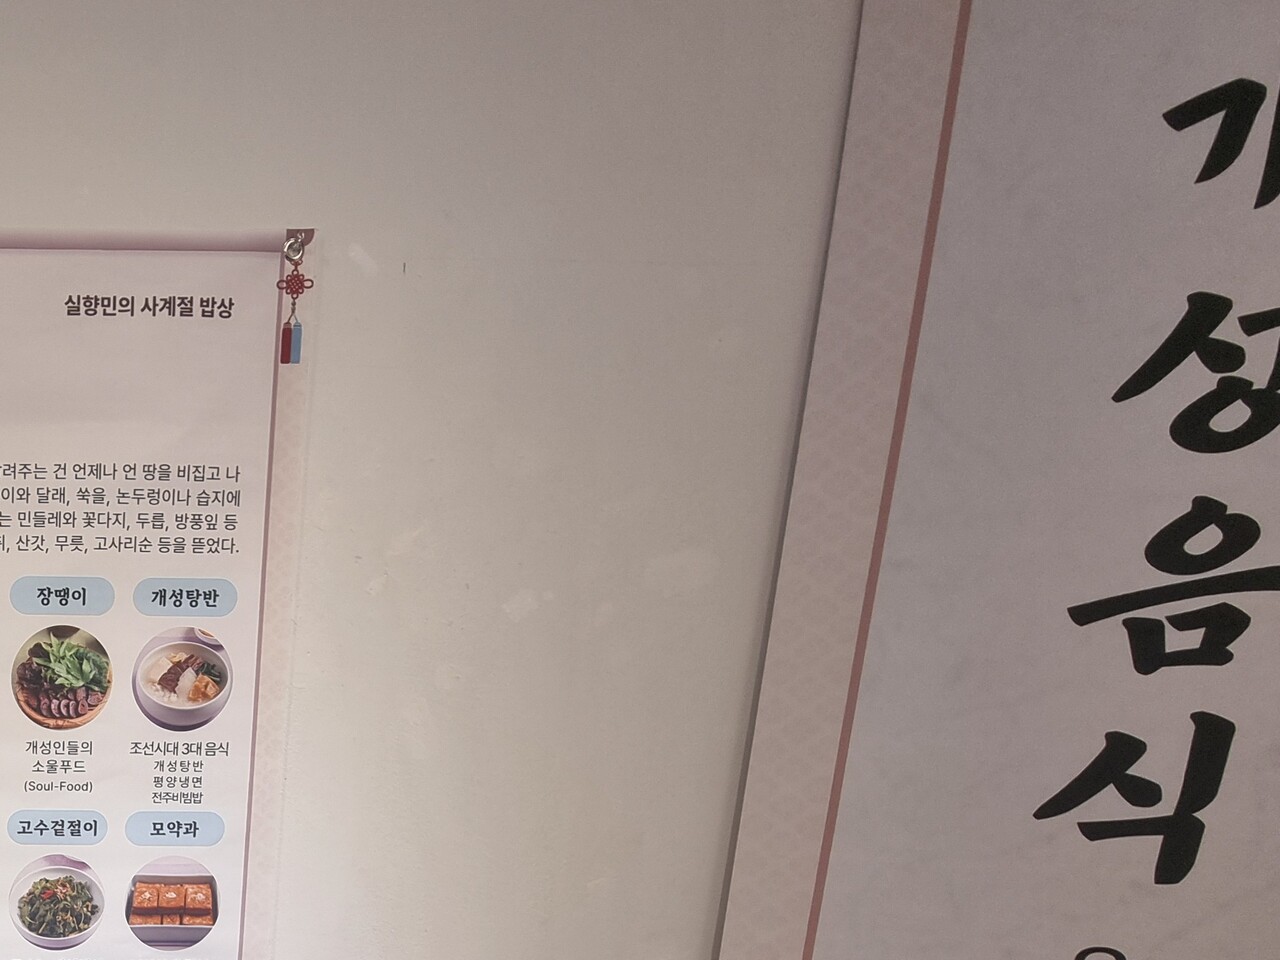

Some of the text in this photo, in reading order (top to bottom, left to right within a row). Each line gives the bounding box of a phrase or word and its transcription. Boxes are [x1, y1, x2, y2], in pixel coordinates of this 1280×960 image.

[64, 295, 235, 318] 실향민의 사계절 밥상
[53, 463, 67, 480] 건
[73, 463, 117, 480] 언제나
[123, 464, 136, 480] 언
[142, 464, 172, 481] 땅을
[177, 465, 221, 482] 비집고
[226, 466, 240, 483] 나
[36, 487, 70, 506] 달래,
[76, 488, 110, 506] 쑥을,
[116, 488, 191, 506] 논두렁이나
[197, 490, 240, 507] 습지에
[18, 511, 76, 528] 민들레와
[82, 512, 130, 530] 꽃다지,
[136, 513, 168, 530] 두릅,
[175, 514, 218, 530] 방풍잎
[224, 514, 238, 530] 등
[16, 536, 48, 553] 산갓,
[55, 536, 88, 553] 무릇,
[94, 537, 152, 552] 고사리순
[158, 537, 186, 553] 등을
[192, 537, 239, 554] 뜯었다.
[36, 587, 87, 606] 장땡이
[151, 589, 219, 607] 개성탕반
[26, 741, 93, 755] 개성인들의
[130, 742, 229, 756] 조선시대 3대 음식
[32, 760, 86, 774] 소울푸드
[153, 760, 203, 772] 개성탕반
[24, 781, 93, 792] (Soul-Food)
[153, 776, 203, 788] 평양냉면
[152, 792, 203, 804] 전주비빔밥
[17, 820, 98, 837] 고수겉절이
[150, 821, 199, 837] 모약과
